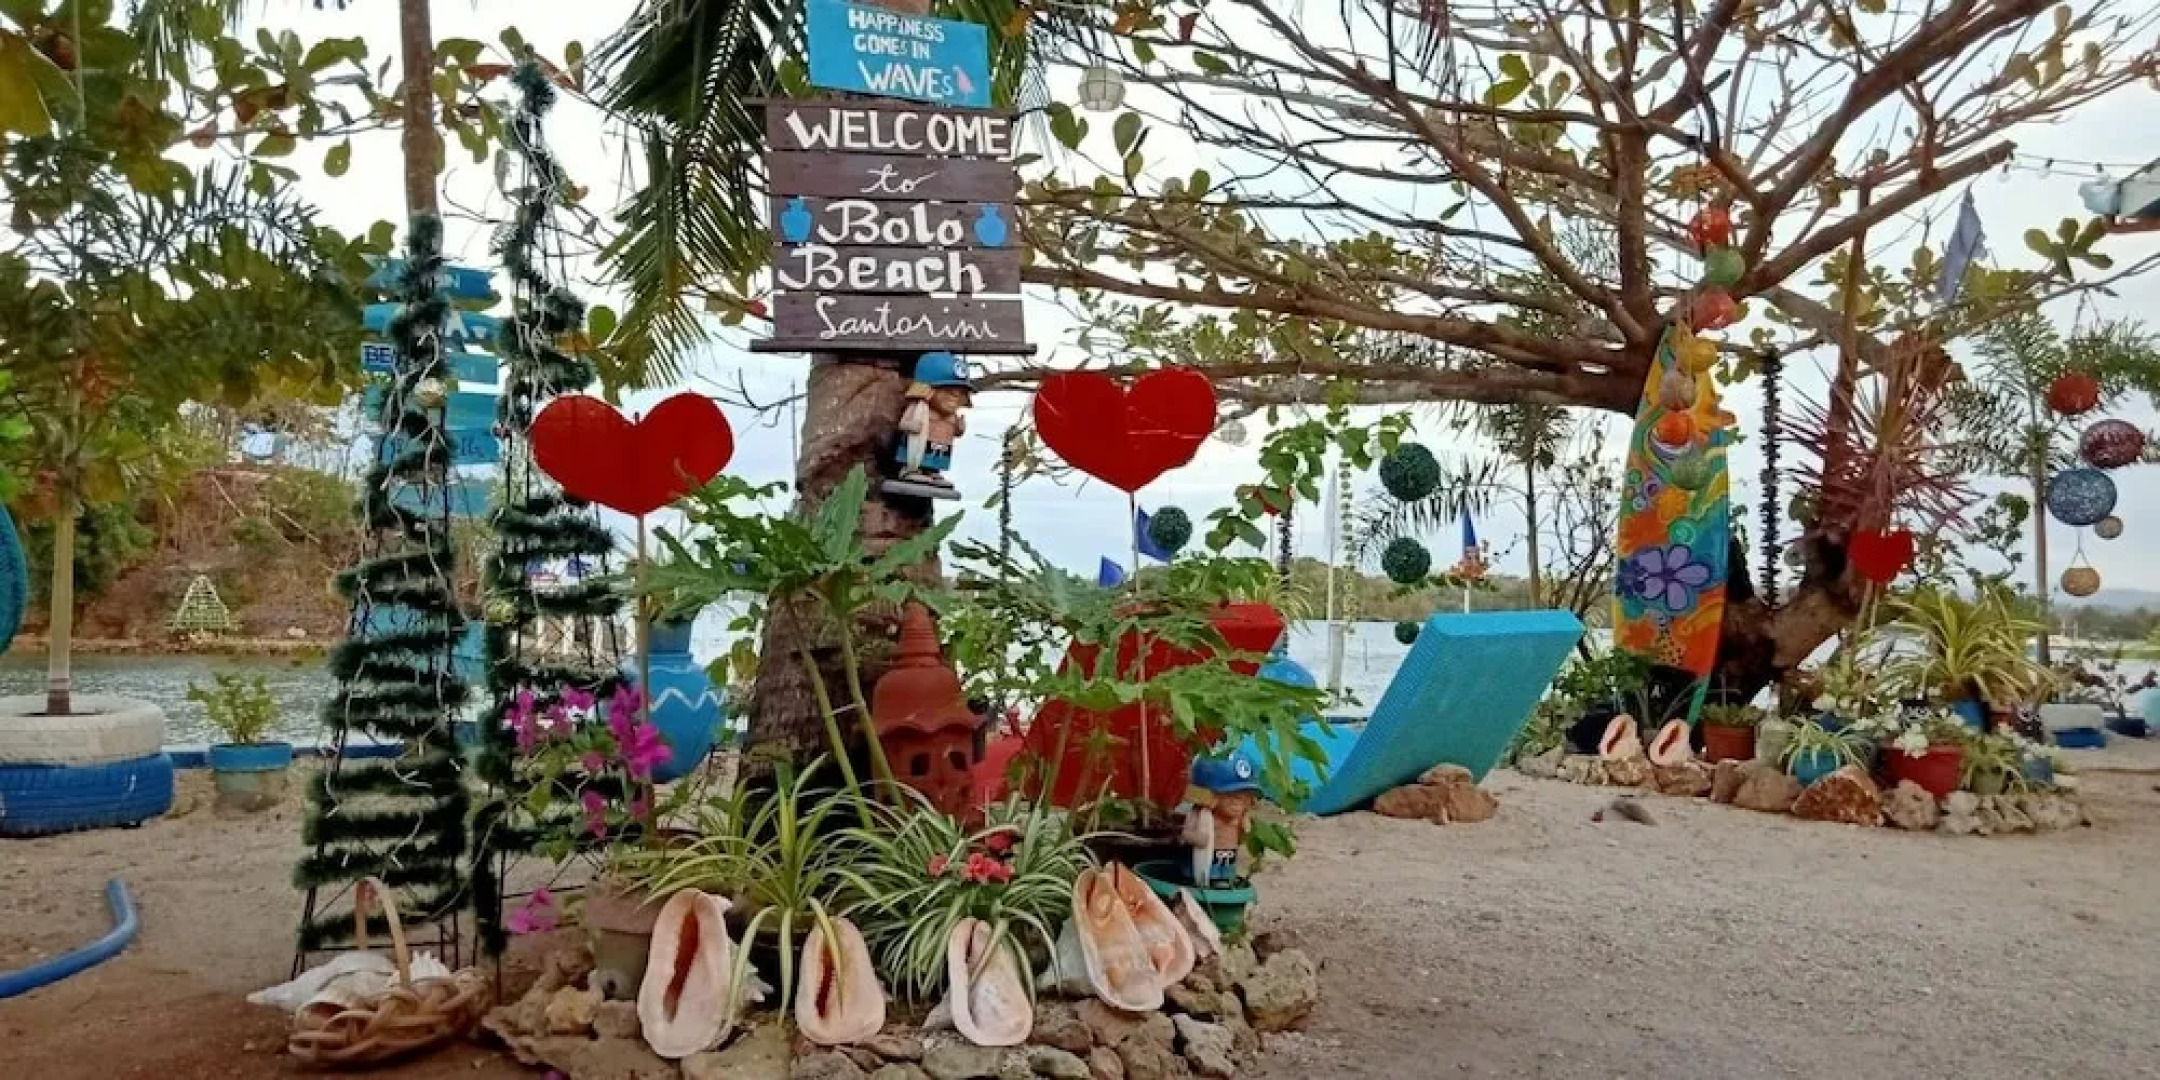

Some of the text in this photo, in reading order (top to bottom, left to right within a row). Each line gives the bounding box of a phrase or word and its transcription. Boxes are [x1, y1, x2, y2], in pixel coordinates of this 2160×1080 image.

[849, 8, 944, 41] HAPPINESS
[911, 41, 930, 59] IN
[785, 109, 1008, 154] WELCOME
[860, 164, 940, 193] to
[817, 200, 964, 244] Bolo
[815, 296, 999, 340] Santorini
